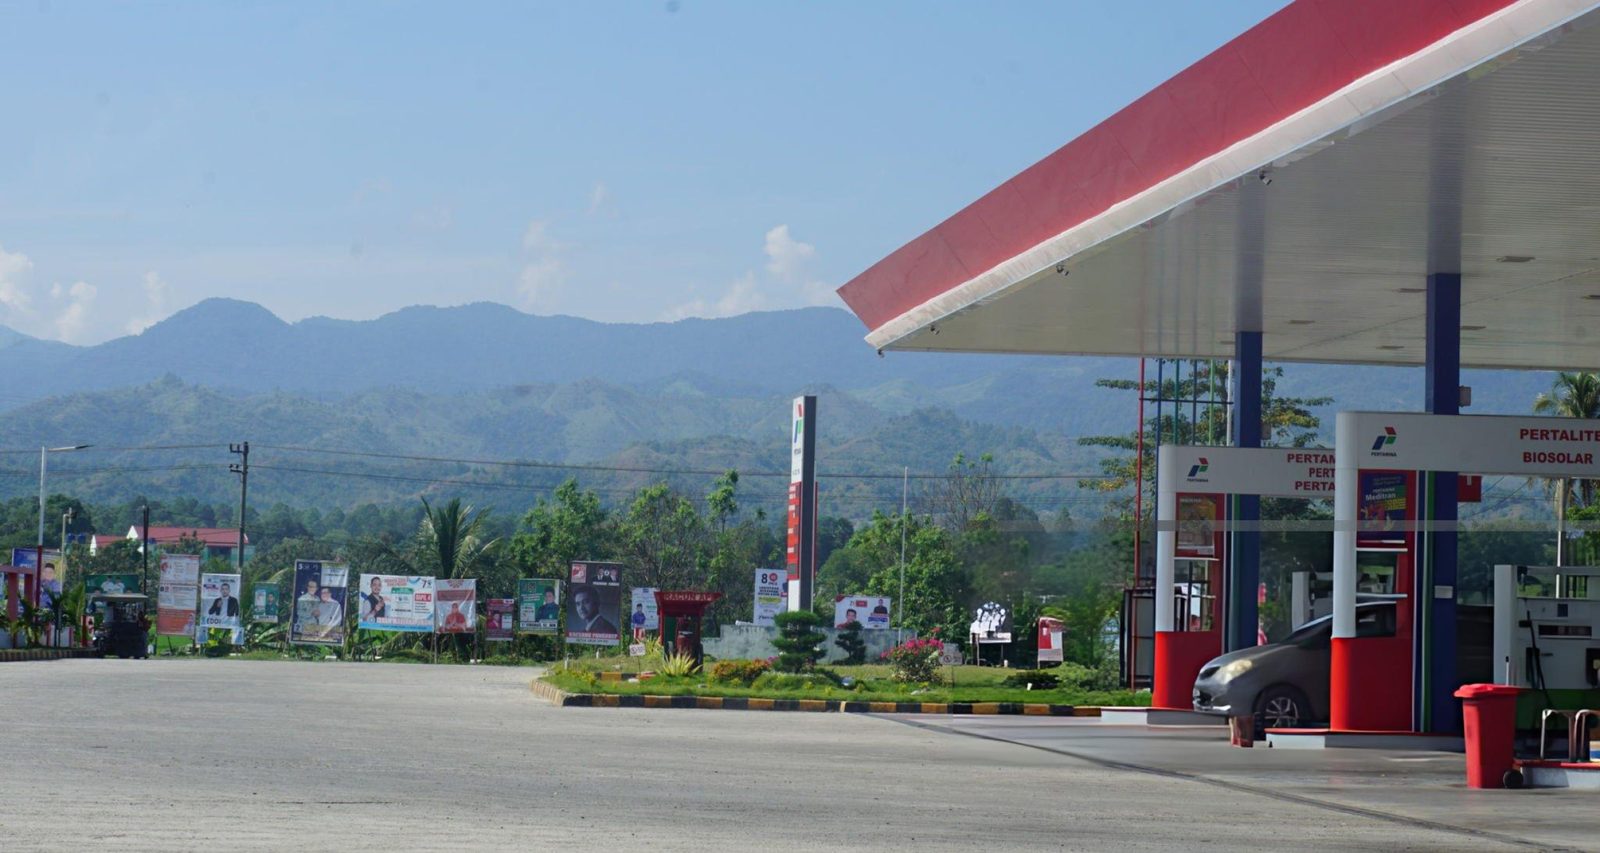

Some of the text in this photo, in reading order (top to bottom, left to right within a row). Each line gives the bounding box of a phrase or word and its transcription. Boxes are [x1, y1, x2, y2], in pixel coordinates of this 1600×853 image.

[1520, 429, 1600, 441] PERTALITE
[1523, 452, 1593, 464] BIOSOLAR
[761, 573, 767, 583] 8
